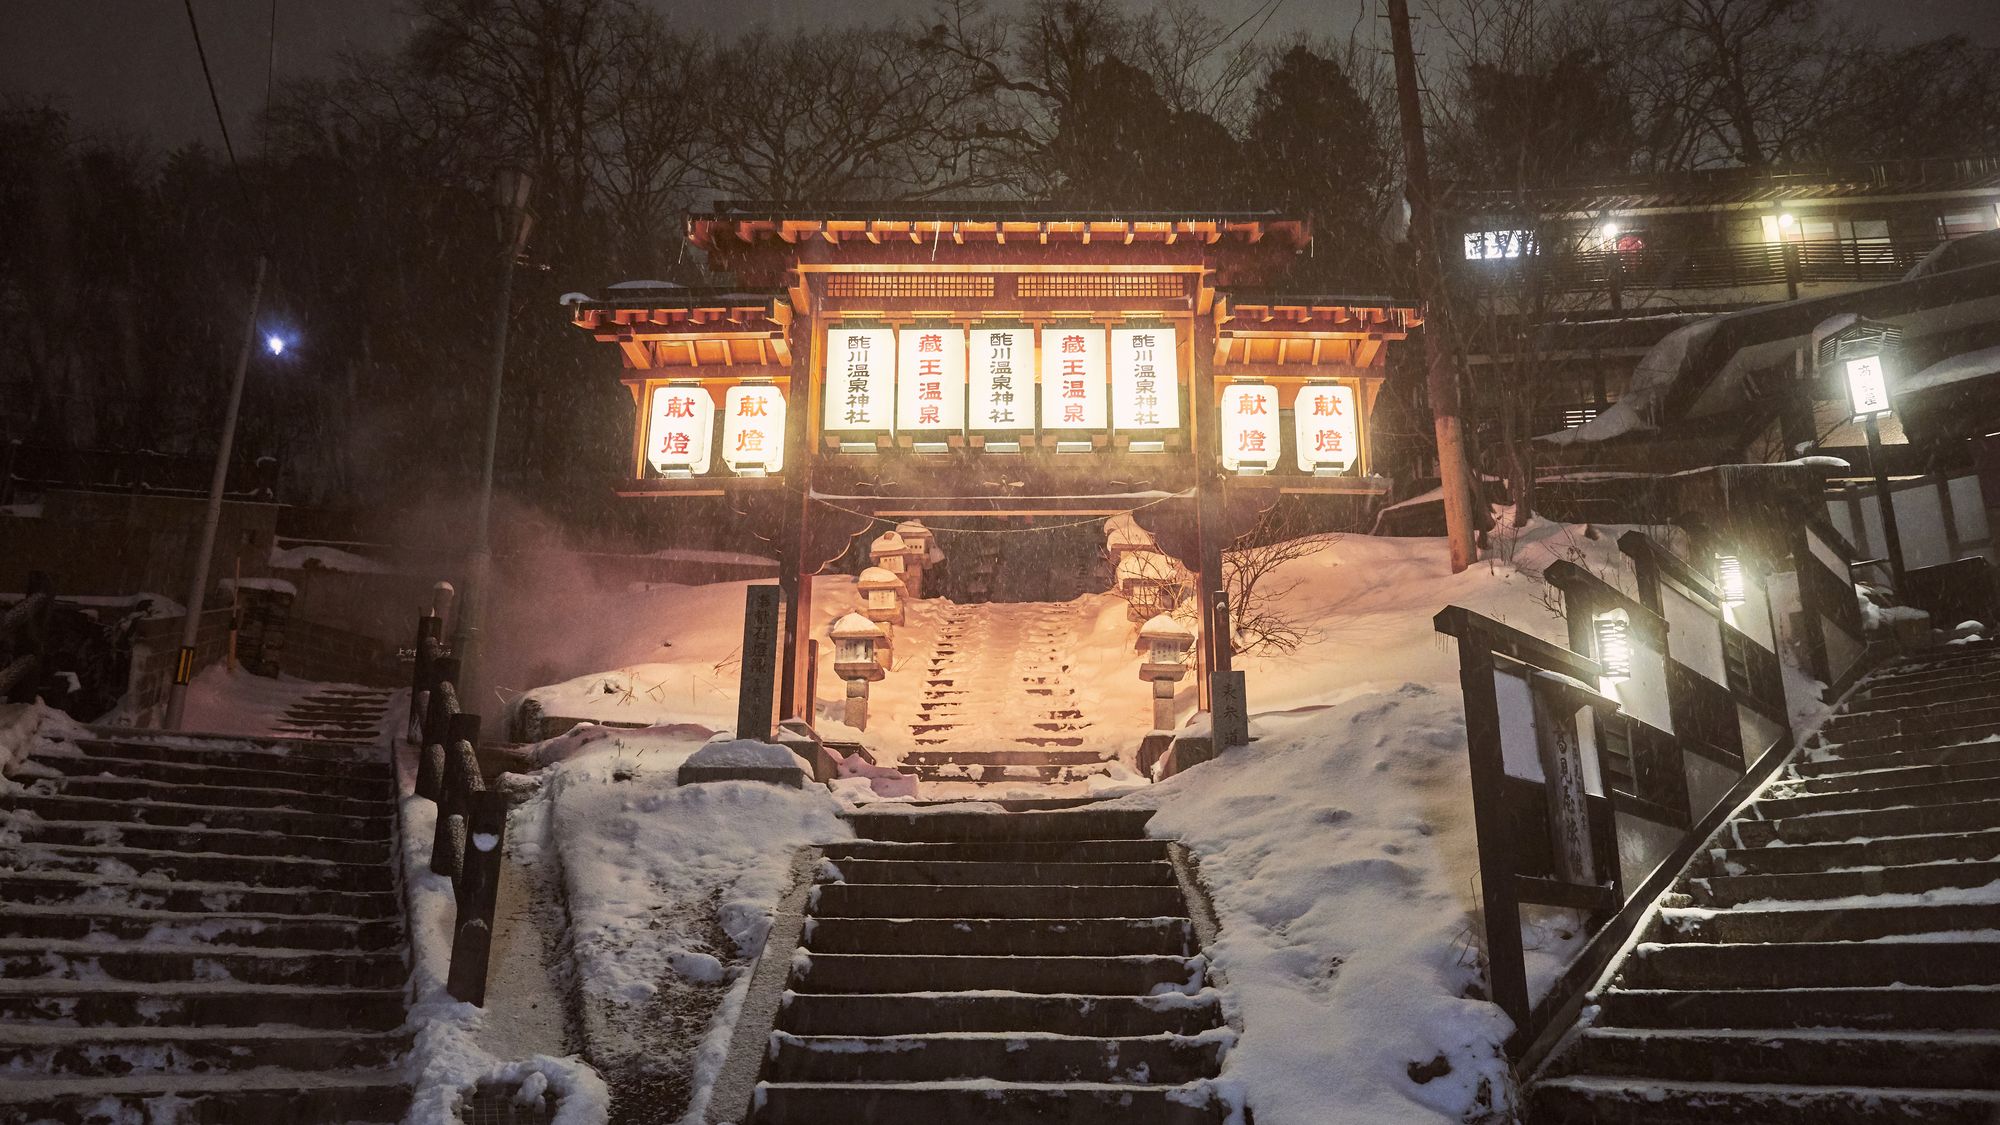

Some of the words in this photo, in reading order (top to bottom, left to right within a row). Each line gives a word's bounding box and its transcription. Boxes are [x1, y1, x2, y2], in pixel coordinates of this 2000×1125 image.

[844, 335, 872, 425] 酢川温泉神社
[917, 334, 943, 424] 蔵王温泉
[988, 332, 1015, 424] 酢川温泉神社
[1061, 334, 1087, 423] 蔵王温泉
[1132, 333, 1160, 426] 酢川温泉神社
[661, 395, 695, 456] 献燈
[735, 395, 769, 453] 献燈
[1236, 392, 1268, 453] 献燈
[1312, 393, 1344, 453] 献燈
[1223, 682, 1240, 746] 表参道
